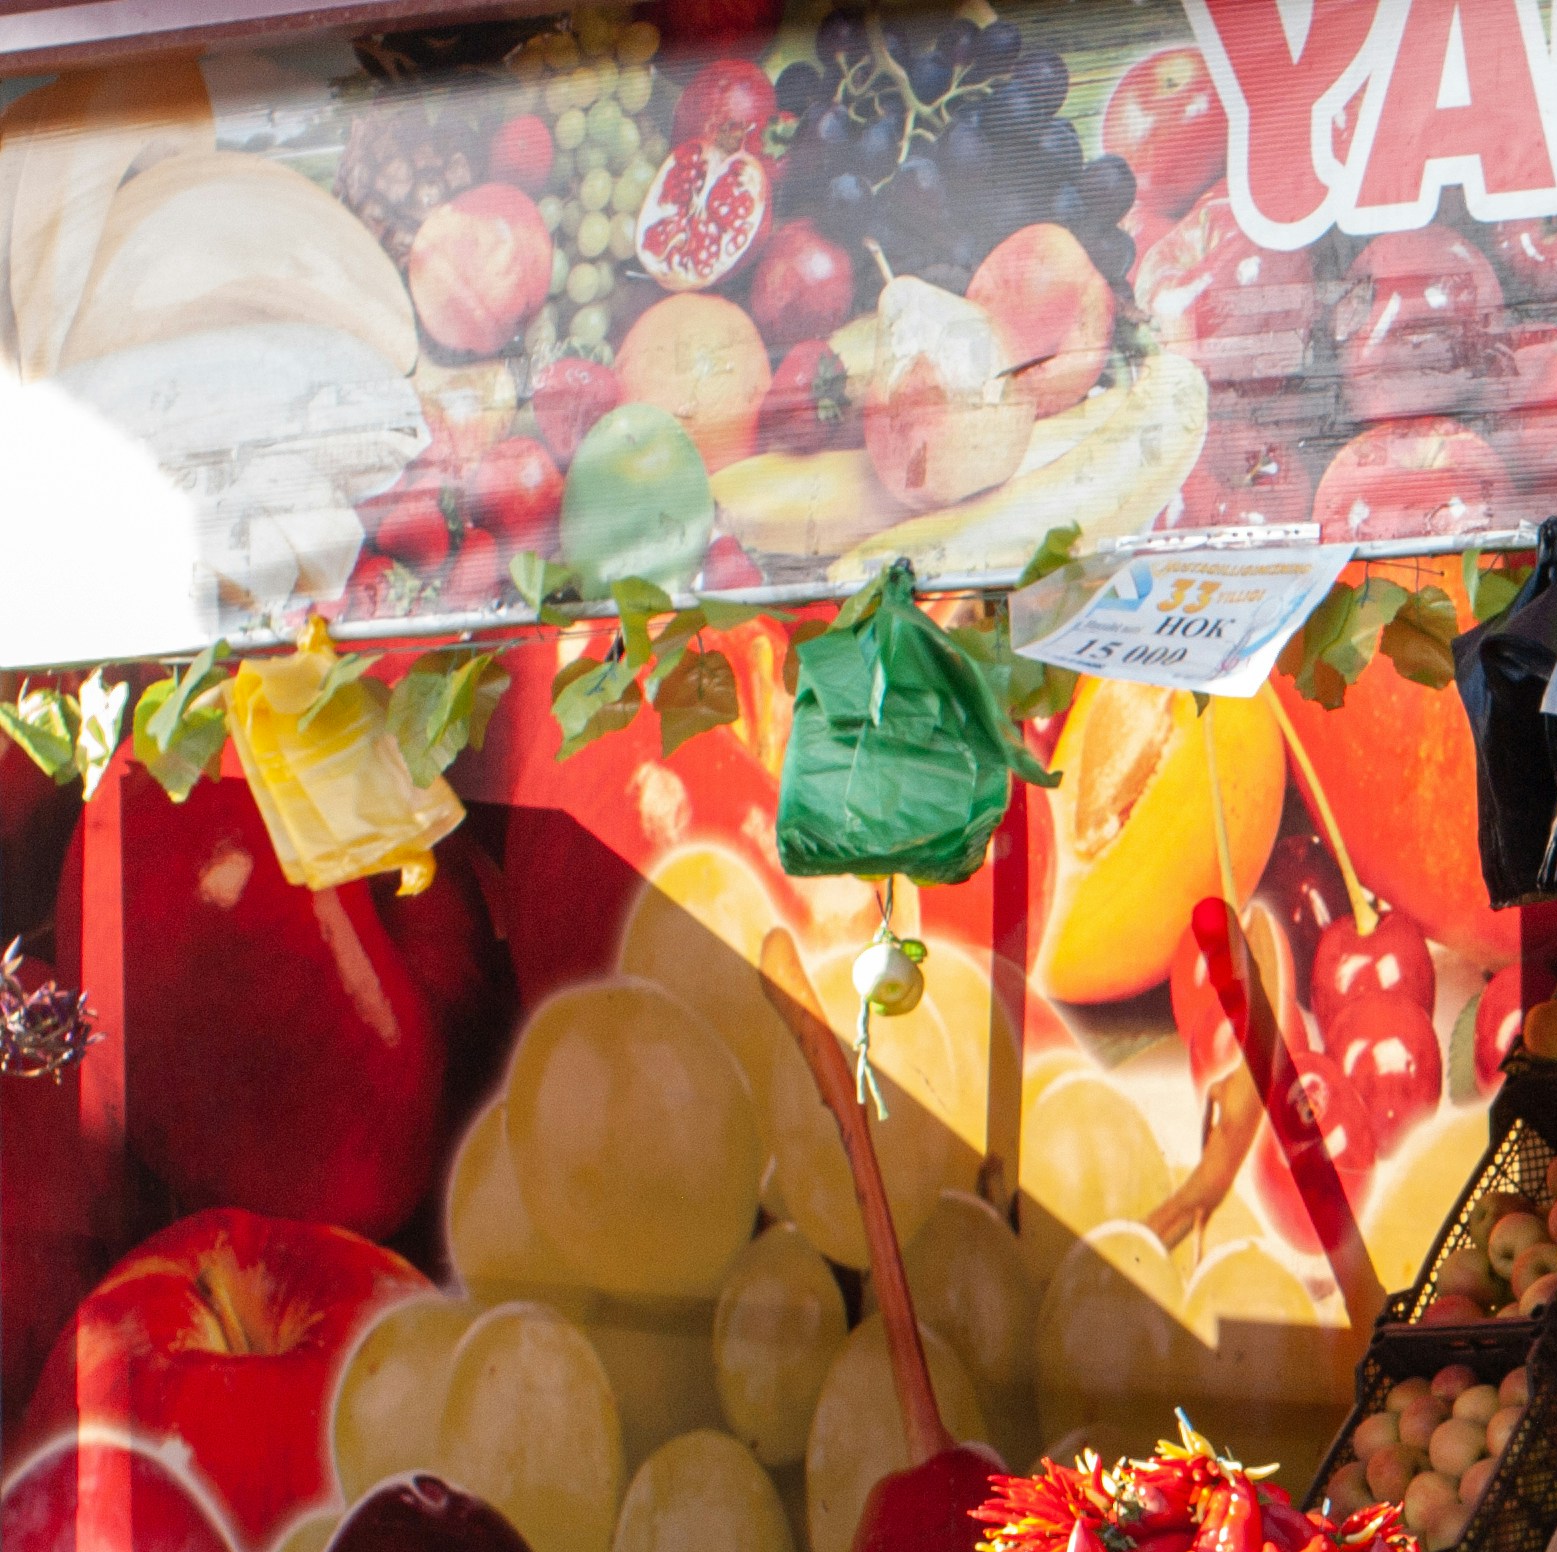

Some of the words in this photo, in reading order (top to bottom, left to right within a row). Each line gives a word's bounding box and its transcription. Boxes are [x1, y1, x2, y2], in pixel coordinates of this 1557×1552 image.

[1157, 578, 1223, 614] 33
[1076, 639, 1122, 660] 15
[1122, 644, 1188, 666] 000
